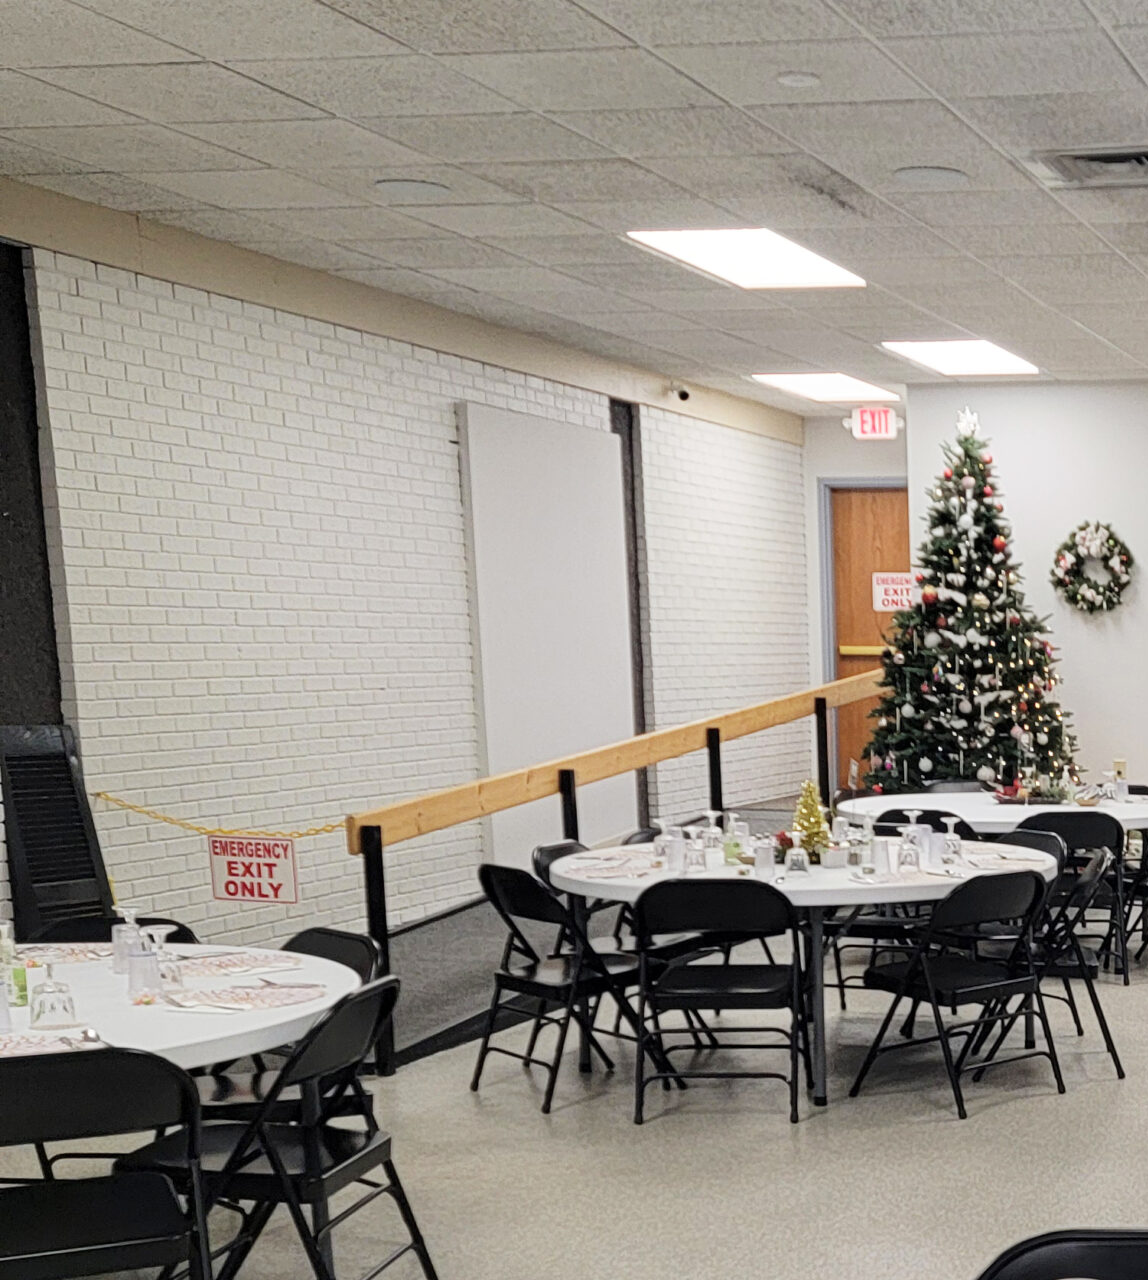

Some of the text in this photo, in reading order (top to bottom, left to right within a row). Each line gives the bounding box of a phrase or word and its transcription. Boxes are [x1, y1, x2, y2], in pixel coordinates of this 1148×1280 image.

[860, 409, 890, 435] EXIT
[883, 587, 911, 597] EXIT
[212, 840, 289, 859] EMERGENCY
[227, 861, 277, 878] EXIT
[224, 881, 283, 899] ONLY
